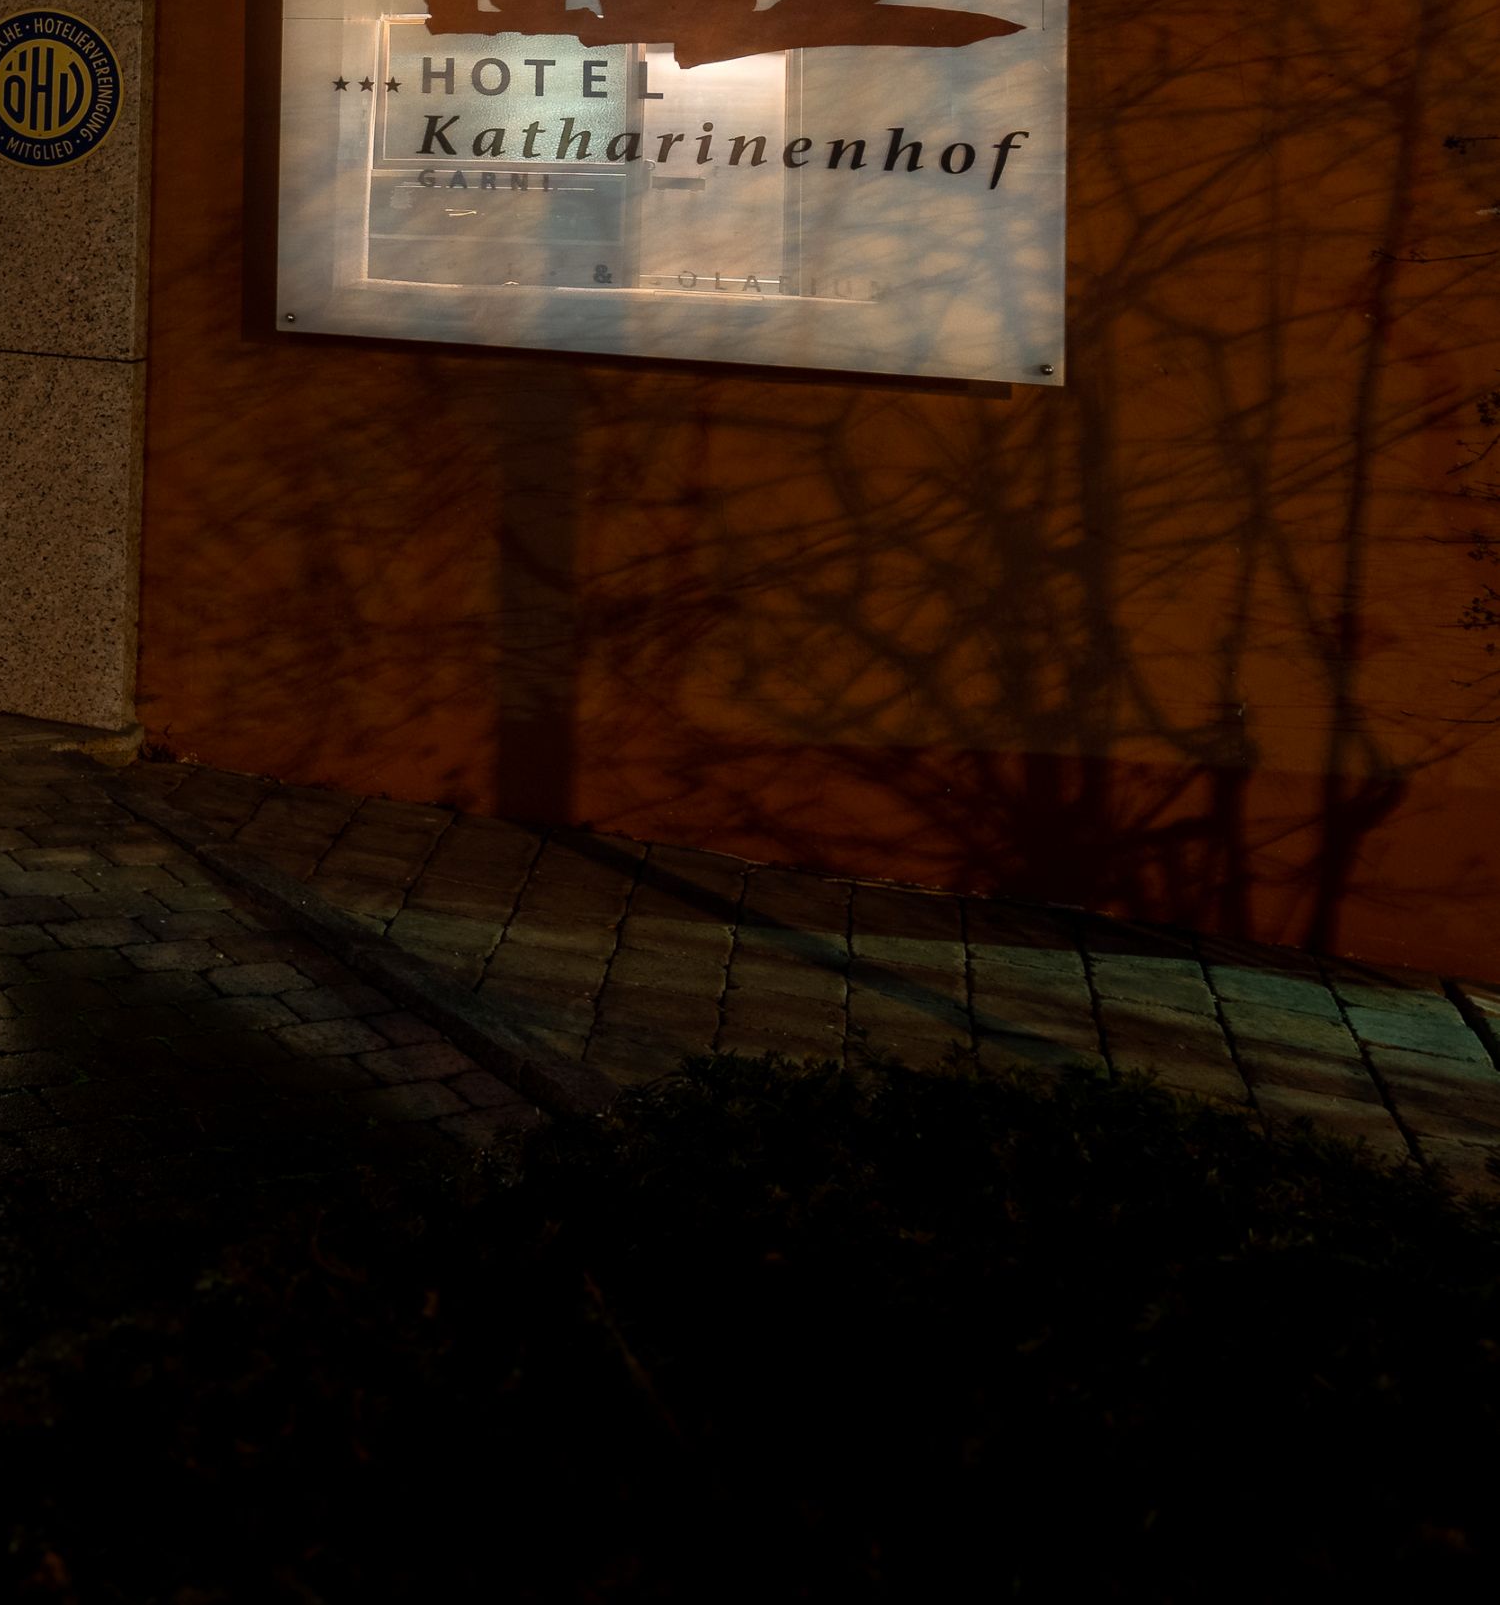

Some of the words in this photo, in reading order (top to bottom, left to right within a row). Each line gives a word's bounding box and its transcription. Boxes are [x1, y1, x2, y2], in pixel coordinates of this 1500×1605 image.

[34, 18, 113, 142] HOTELIERVEREINIGUNG
[421, 57, 664, 100] HOTEL
[6, 136, 74, 161] MITGLIED
[416, 114, 1030, 189] Katharinenhof
[416, 168, 551, 192] GARNI
